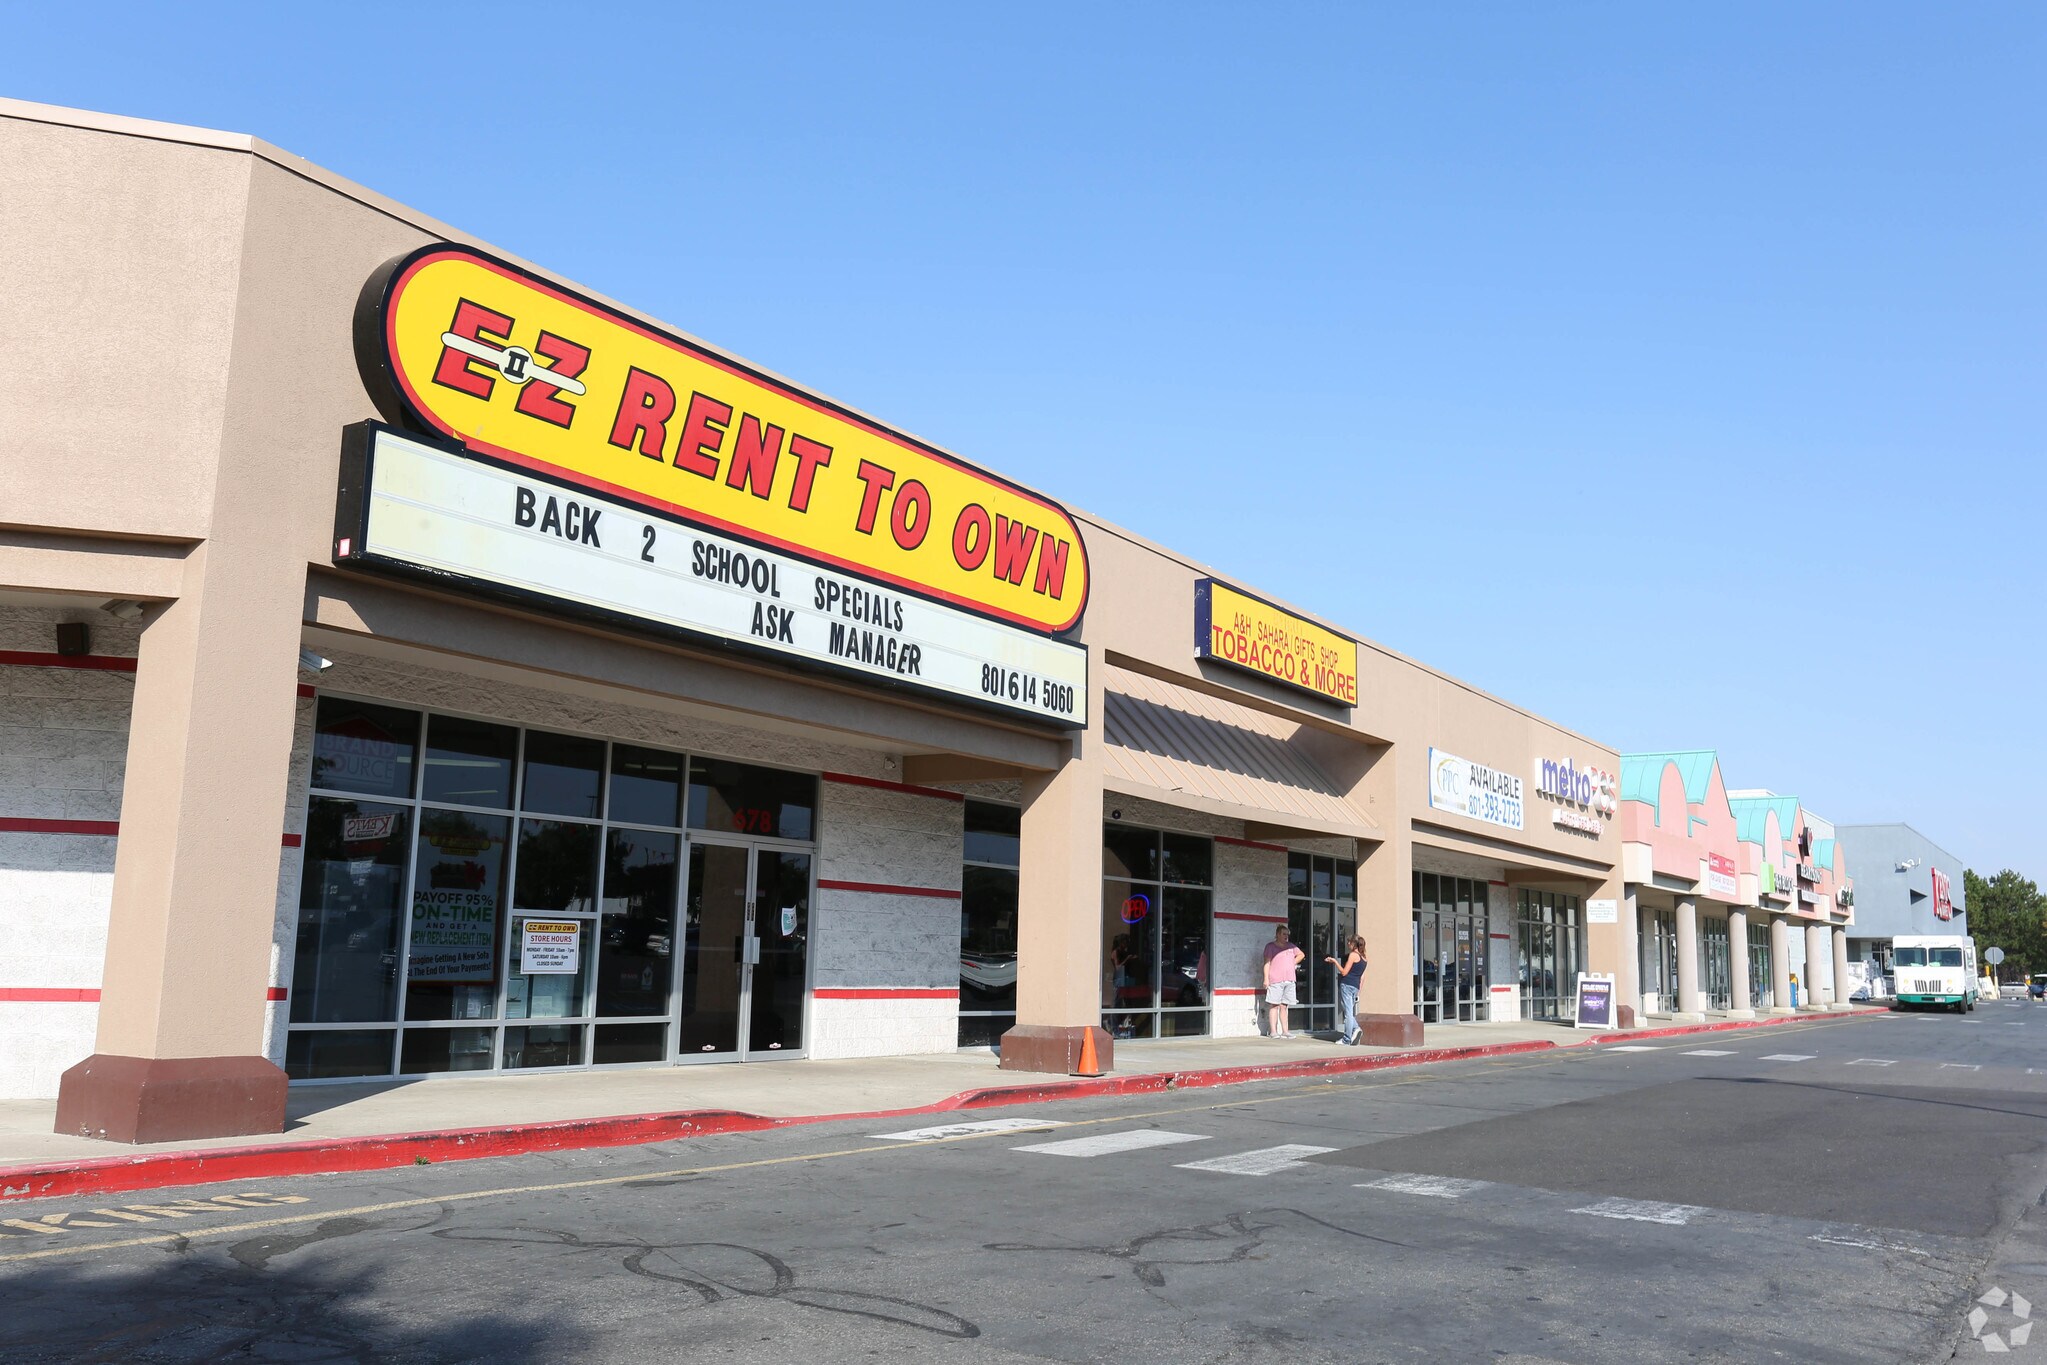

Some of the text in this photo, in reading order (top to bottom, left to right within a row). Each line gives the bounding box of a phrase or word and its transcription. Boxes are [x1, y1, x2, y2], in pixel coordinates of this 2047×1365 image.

[607, 366, 833, 513] RENT
[855, 458, 931, 551] TO
[952, 503, 1070, 600] OWN
[514, 486, 903, 632] BACK 2 SCHOOL SPECIALS
[750, 602, 794, 644] ASK
[829, 622, 921, 675] MANAGER
[1233, 612, 1251, 637] A&H
[1257, 621, 1289, 651] SAHARA
[1294, 635, 1315, 661] GIFTS
[1321, 646, 1339, 669] SHOP
[1212, 624, 1355, 701] TOBACCO & MORE
[1469, 765, 1519, 799] AVAILABLE
[733, 808, 772, 833] 678
[1468, 792, 1521, 827] 801-393-2733
[413, 904, 493, 922] ON-TIME
[414, 891, 494, 906] PAYOFF 95%
[1121, 898, 1147, 919] OPEN
[427, 931, 476, 945] REPLACEMENT
[476, 933, 492, 946] ITEM
[530, 935, 572, 943] STORE HOURS
[435, 953, 456, 964] Getting
